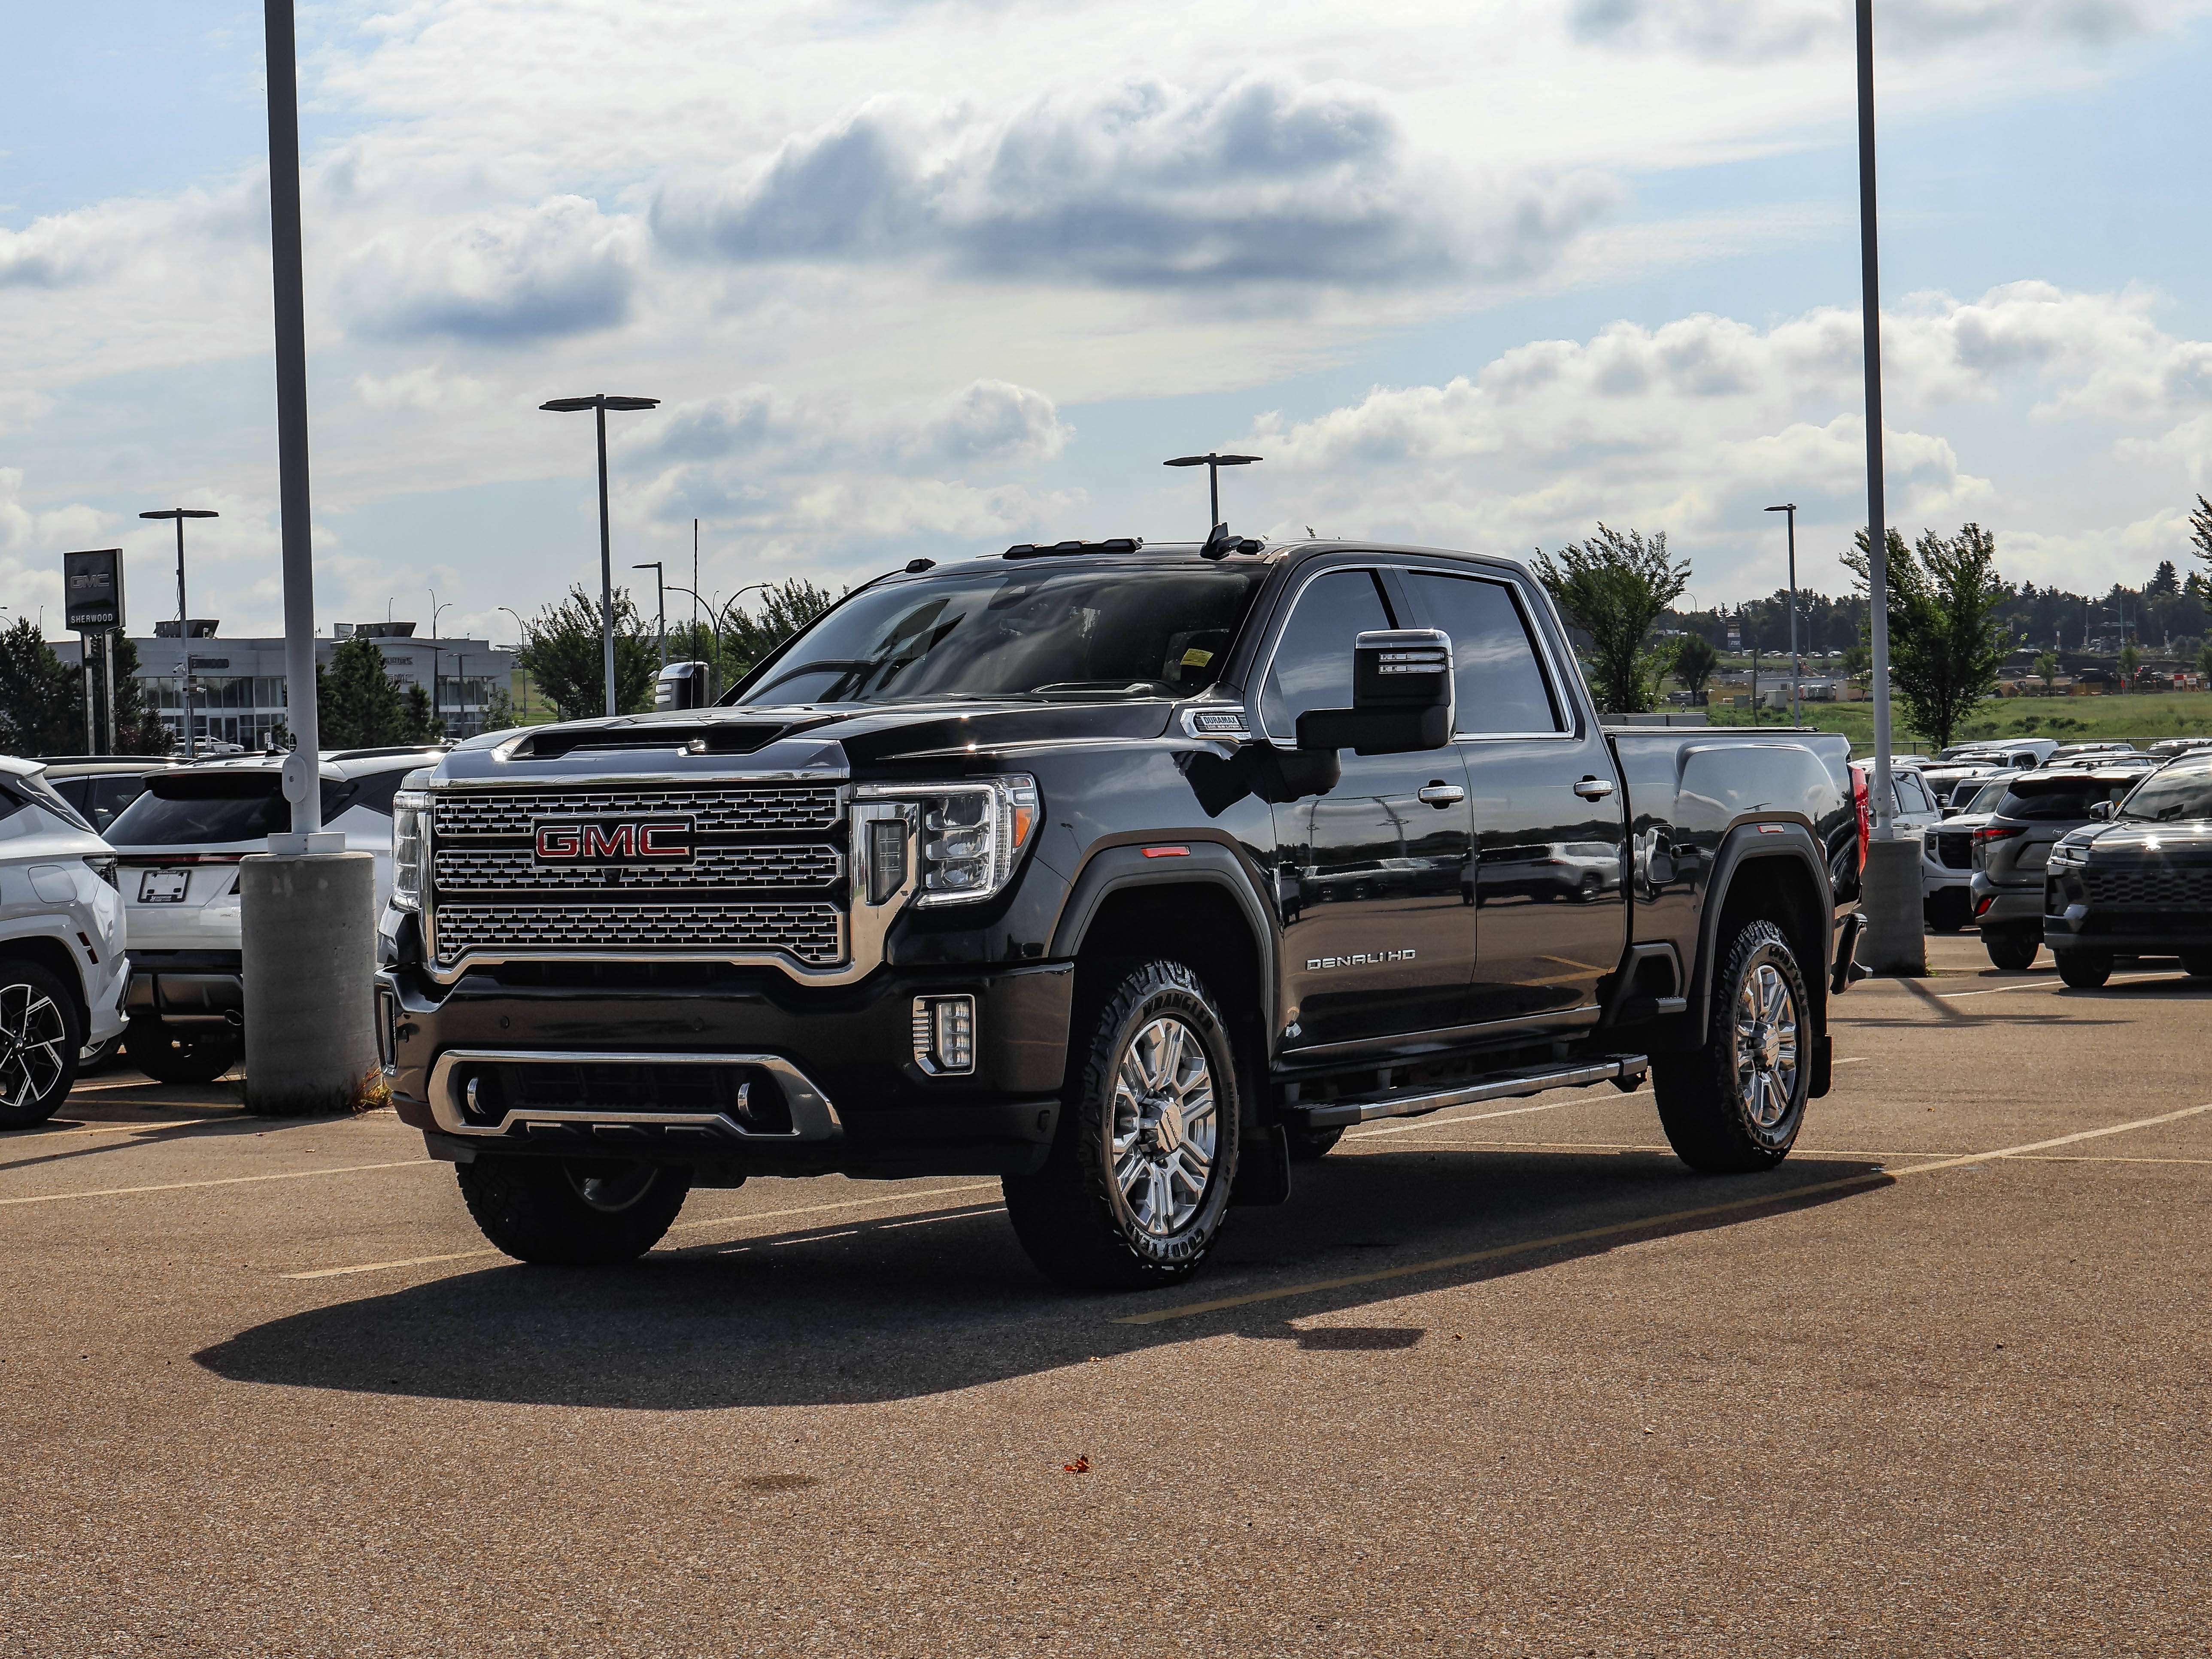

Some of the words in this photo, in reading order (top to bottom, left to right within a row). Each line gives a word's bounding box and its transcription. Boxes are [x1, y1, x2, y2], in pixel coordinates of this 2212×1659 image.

[70, 574, 109, 588] GMC
[71, 613, 113, 624] SHERWOOD
[1202, 716, 1237, 724] DURAMAX
[536, 822, 690, 858] GMC
[1306, 952, 1384, 970] DENALI
[1387, 949, 1416, 961] HD
[1143, 993, 1214, 1032] WRANGLER
[1125, 1222, 1205, 1259] GOODYEAR
